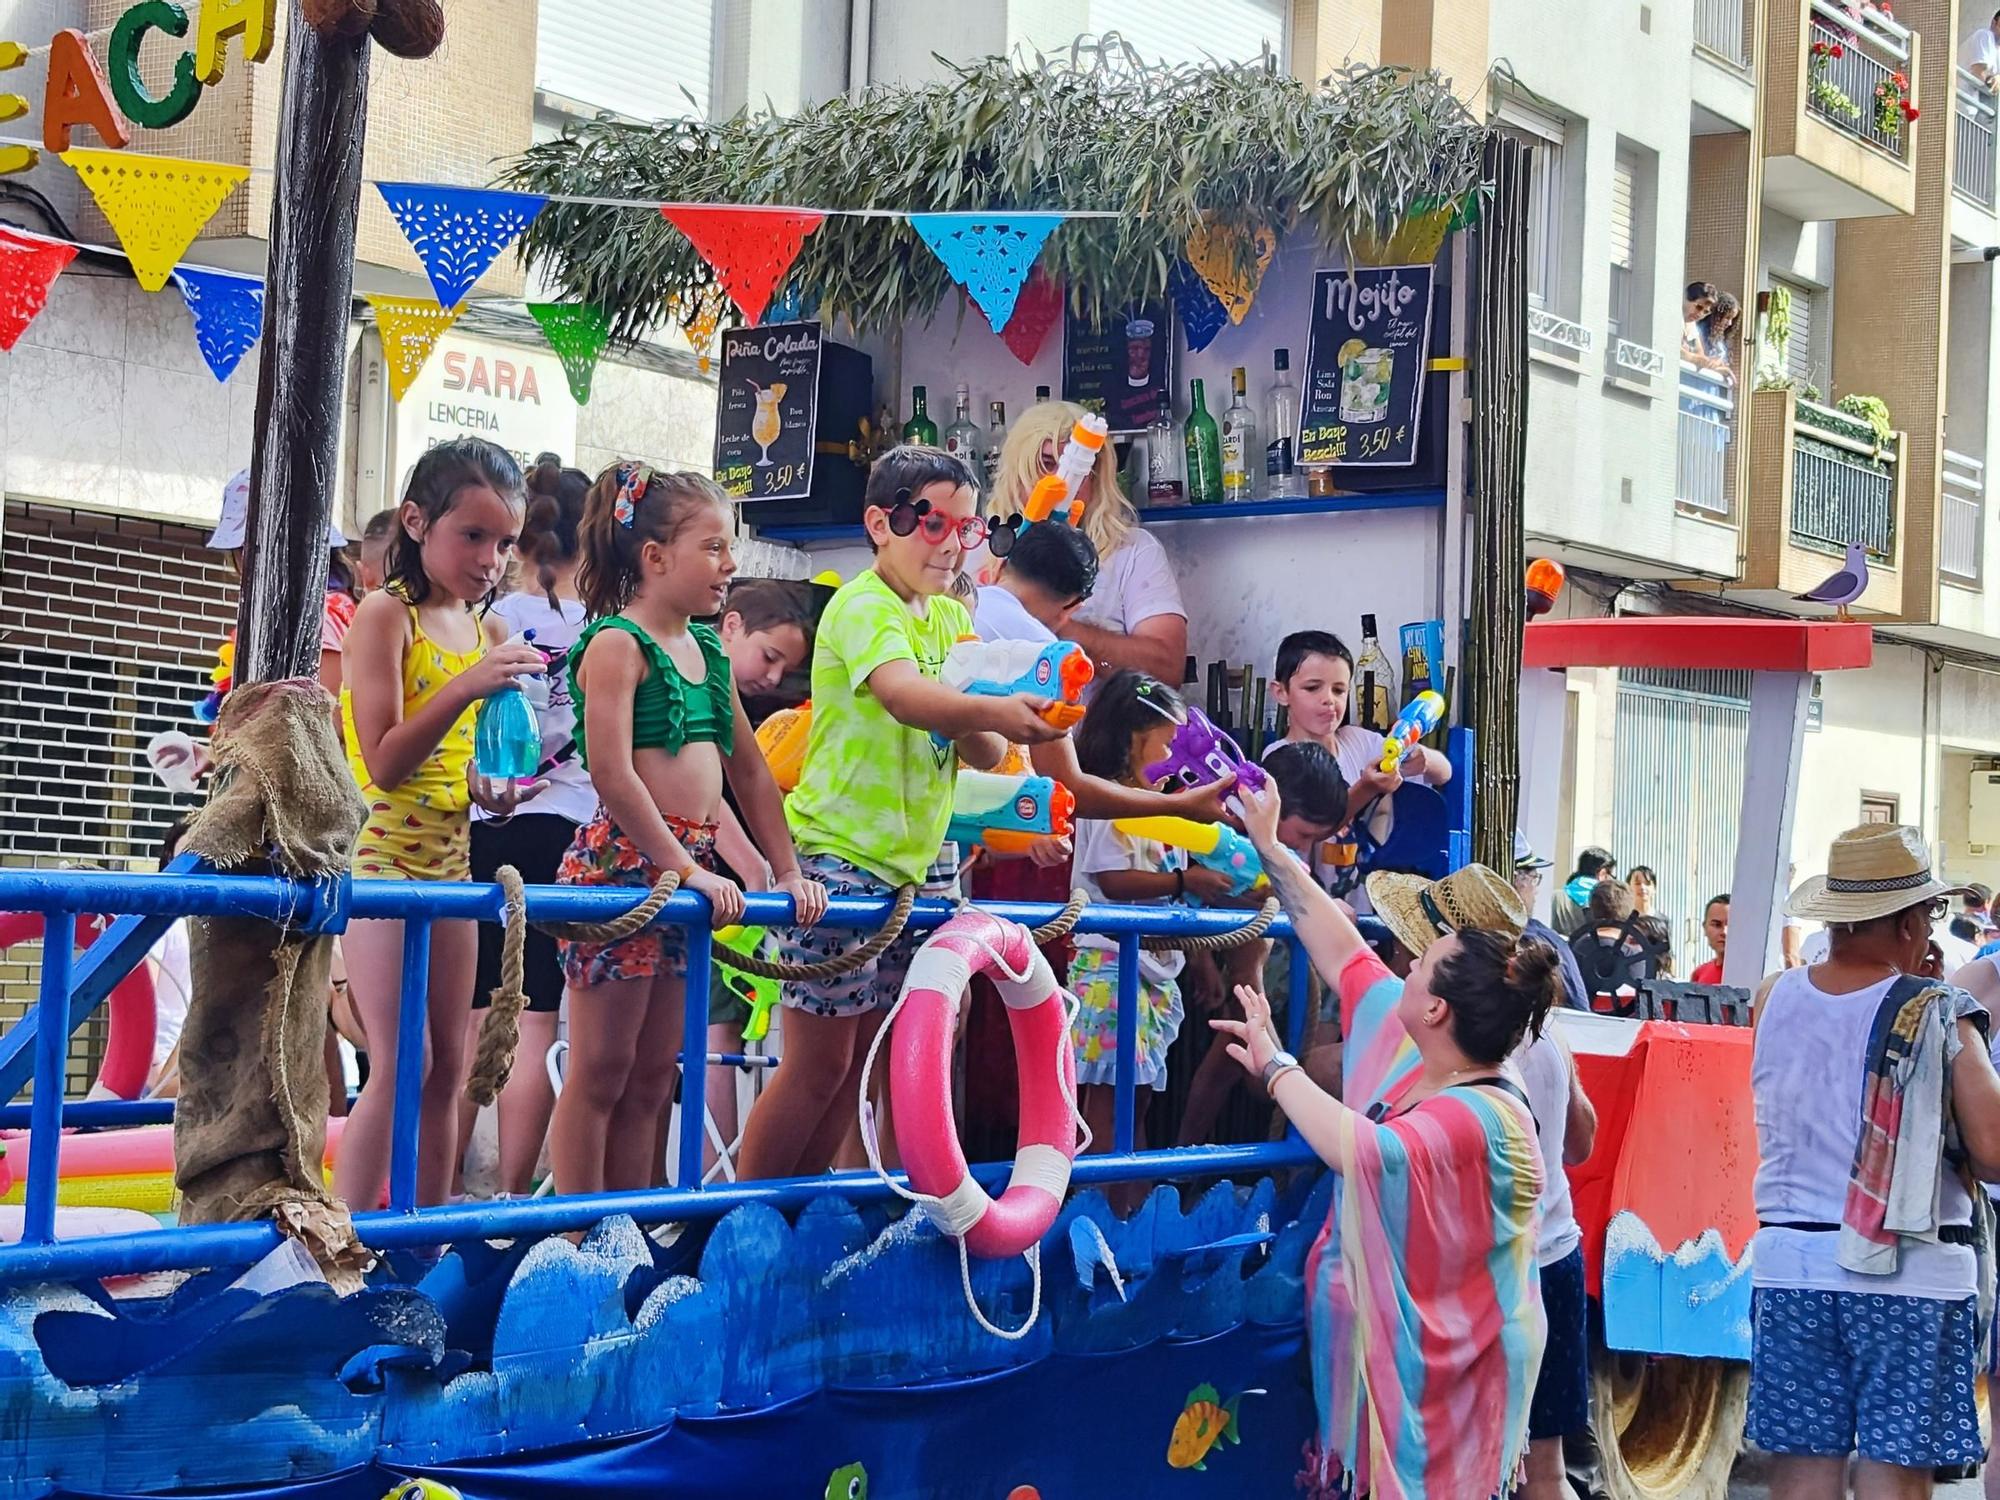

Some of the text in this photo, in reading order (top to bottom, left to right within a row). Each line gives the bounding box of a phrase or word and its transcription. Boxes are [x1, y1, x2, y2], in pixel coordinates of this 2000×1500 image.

[1326, 270, 1416, 331] Mojito
[726, 340, 761, 367] Piña
[764, 332, 818, 361] Colada
[443, 351, 541, 405] SARA
[1317, 379, 1335, 388] Soda
[1315, 389, 1332, 400] Ron
[429, 401, 500, 432] LENCERIA
[721, 434, 750, 443] Leche de
[1302, 429, 1316, 443] En
[1415, 627, 1426, 646] KIT
